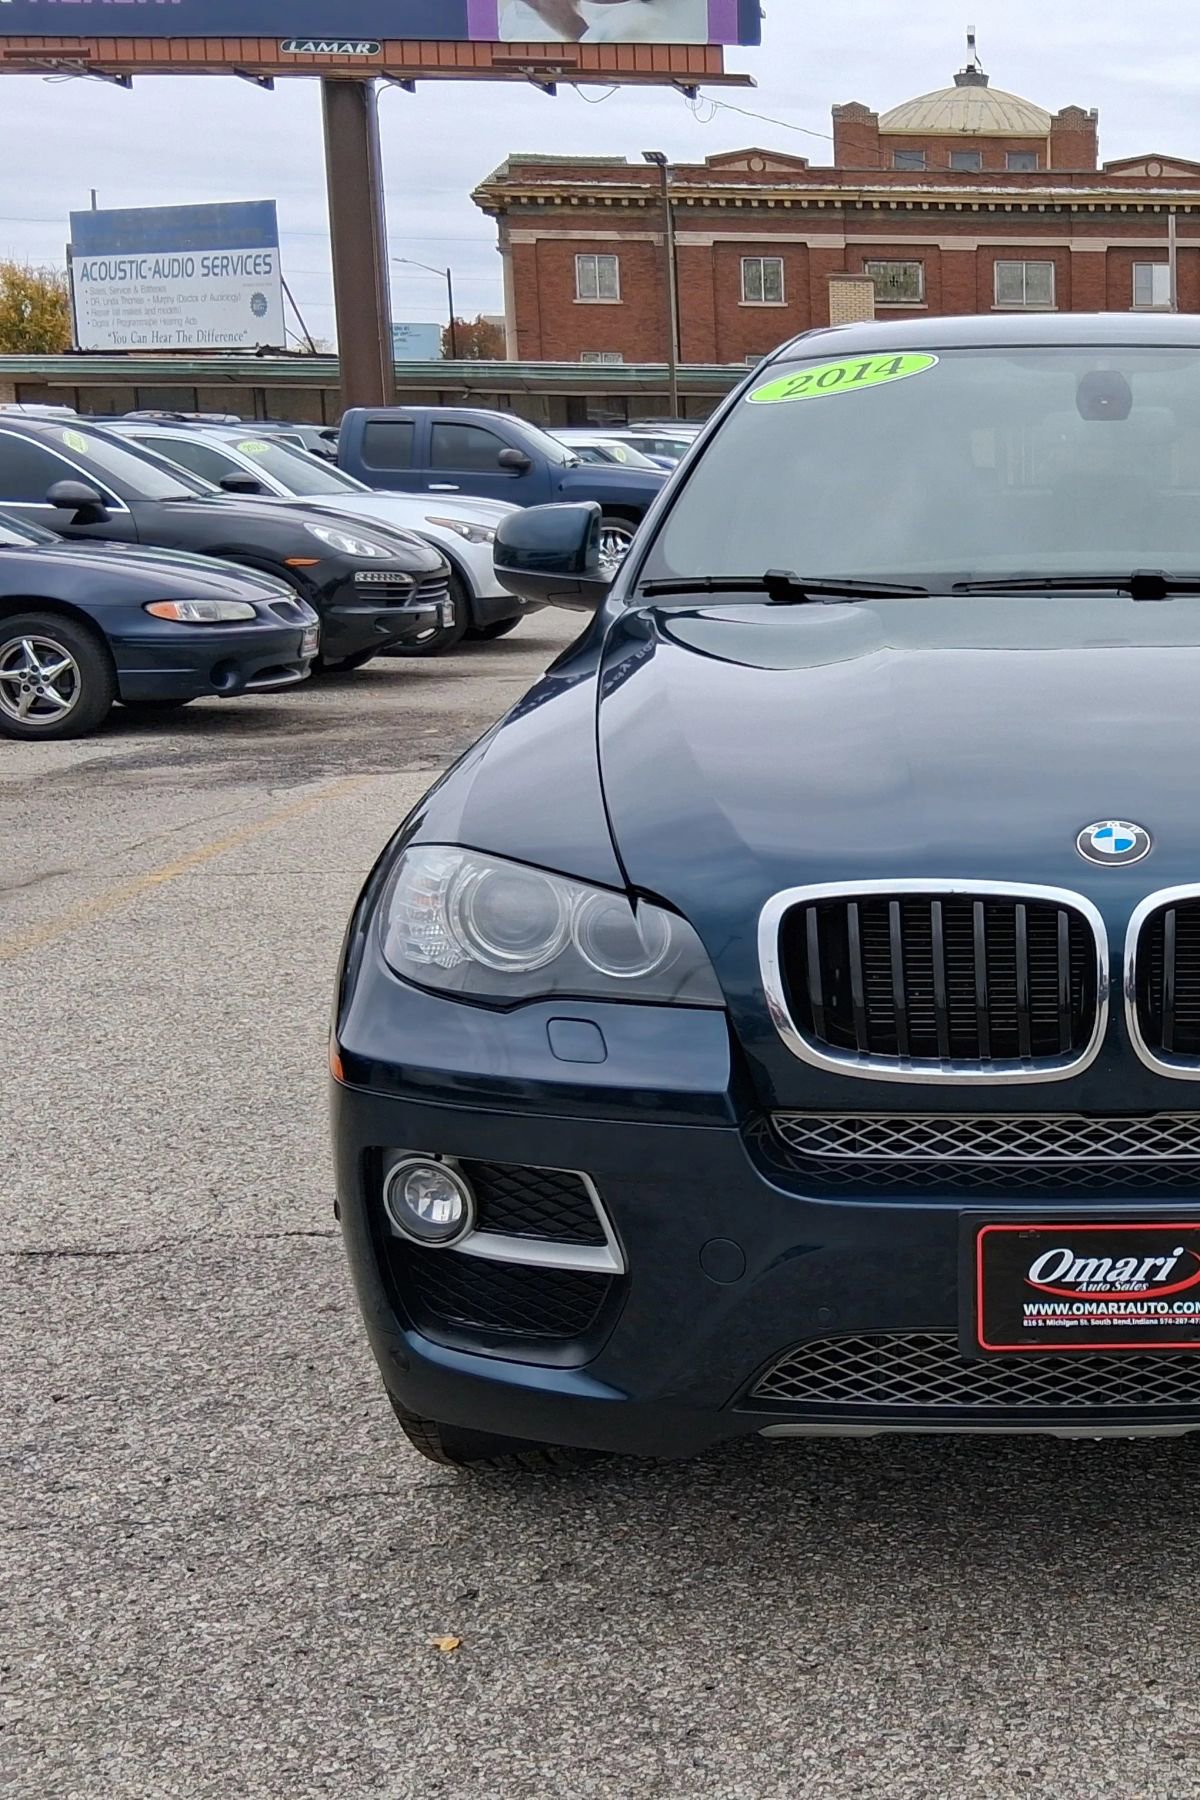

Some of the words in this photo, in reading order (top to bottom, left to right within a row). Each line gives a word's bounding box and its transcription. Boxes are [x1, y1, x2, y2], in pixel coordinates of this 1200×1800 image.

[289, 41, 370, 54] LAMAR
[80, 257, 195, 282] ACOUSTIC-AUDIO
[201, 253, 273, 277] SERVICES
[130, 330, 148, 344] Can
[151, 330, 172, 344] Hear
[175, 329, 193, 343] The
[780, 356, 905, 398] 2014
[1027, 1246, 1185, 1284] Omari
[1075, 1282, 1110, 1292] Auto
[1111, 1281, 1150, 1292] Sales
[1046, 1318, 1079, 1328] Michigan
[1090, 1318, 1112, 1326] South
